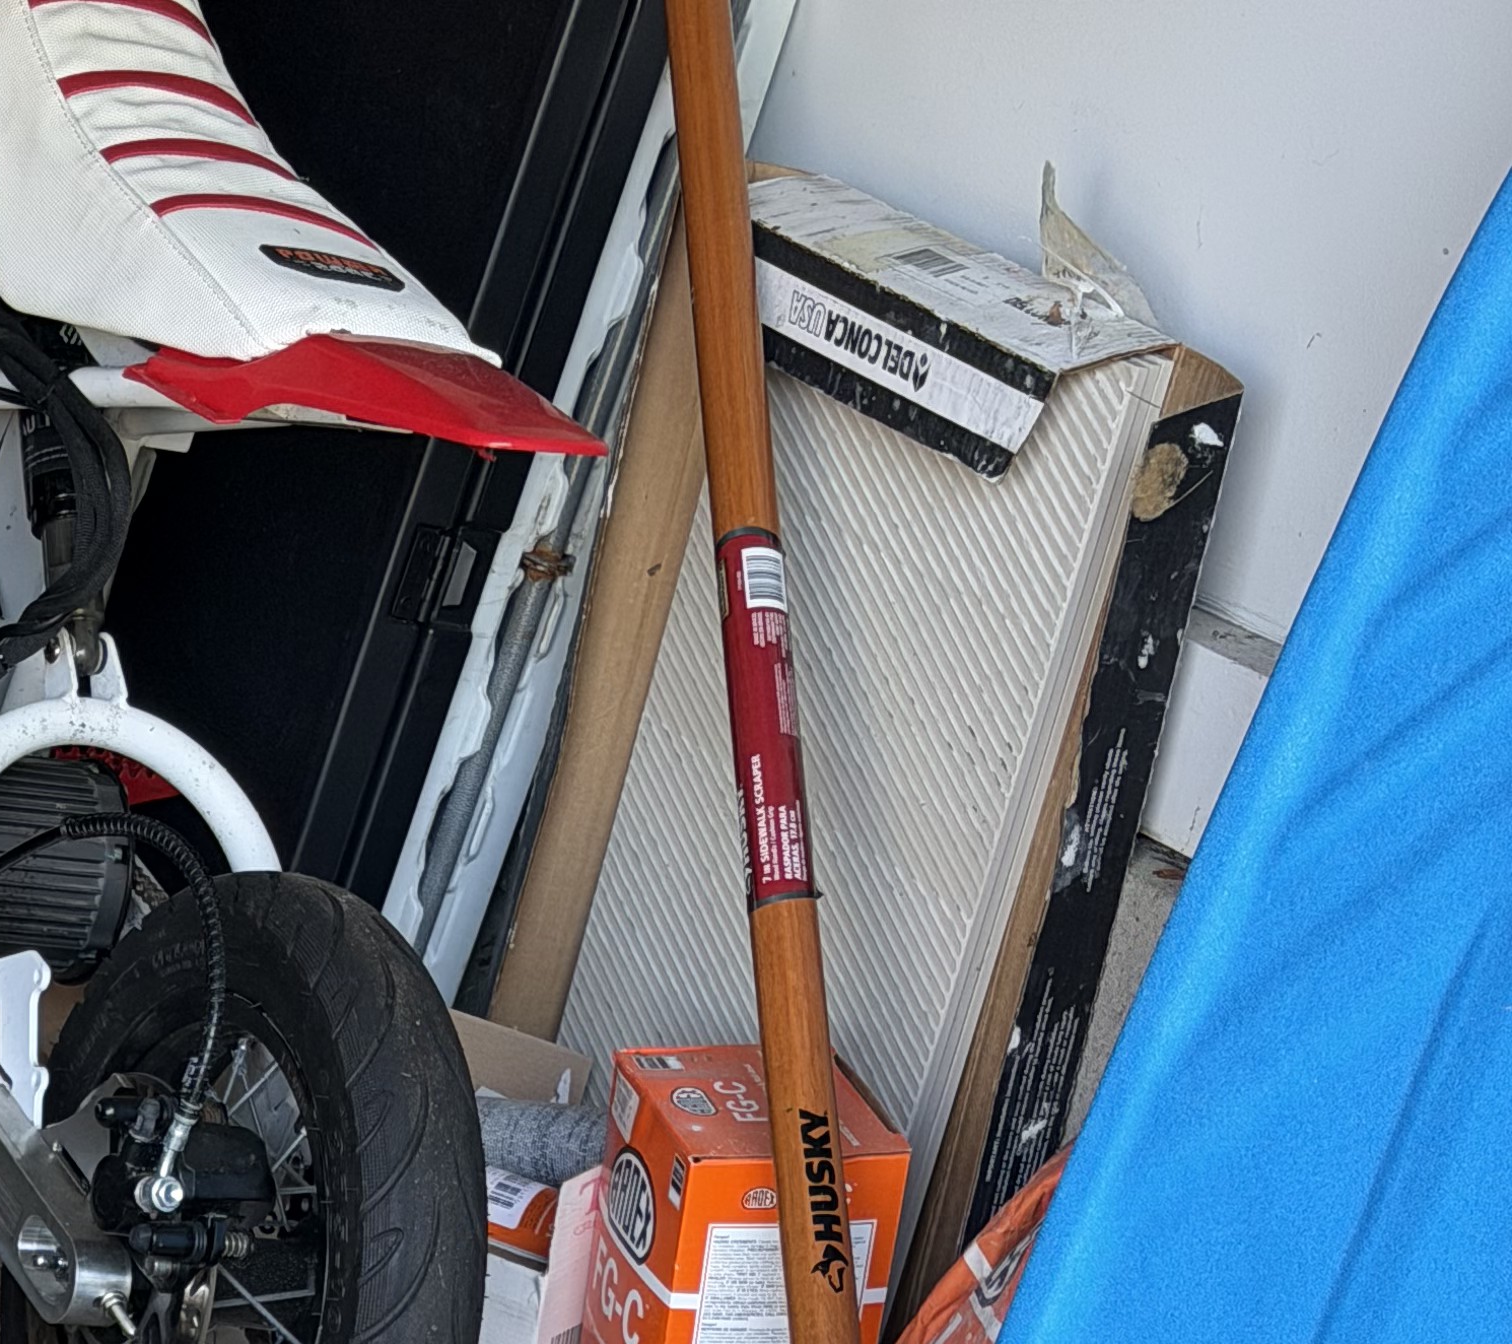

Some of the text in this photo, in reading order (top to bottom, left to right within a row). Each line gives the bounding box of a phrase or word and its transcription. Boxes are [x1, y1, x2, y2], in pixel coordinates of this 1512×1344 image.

[788, 290, 826, 337] USA
[749, 753, 765, 804] SCRAPER
[754, 804, 771, 862] SIDEWALK
[777, 804, 793, 879] RASPADOR PARA
[609, 1151, 653, 1258] ARDEX
[743, 1189, 777, 1209] ARDEX
[799, 1108, 843, 1243] HUSKY
